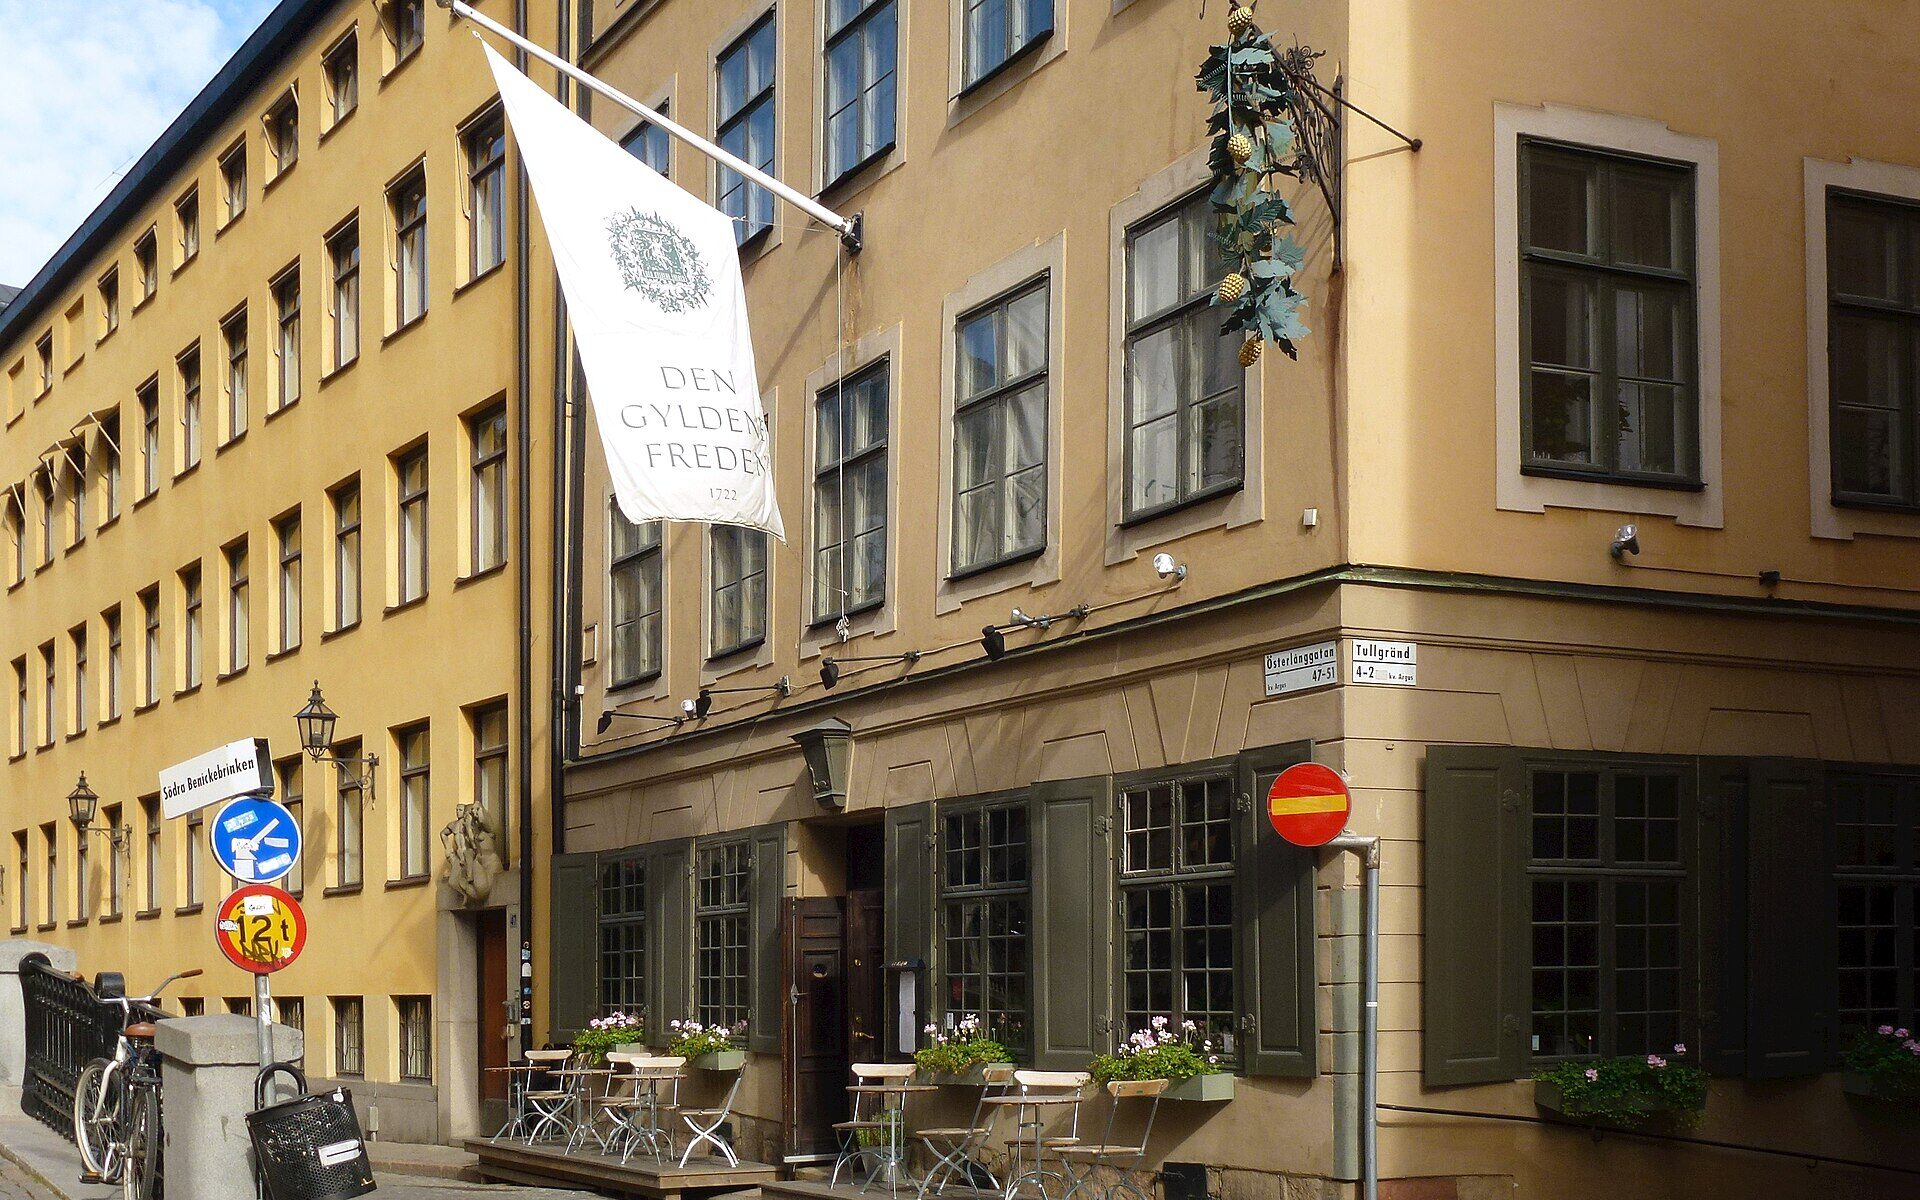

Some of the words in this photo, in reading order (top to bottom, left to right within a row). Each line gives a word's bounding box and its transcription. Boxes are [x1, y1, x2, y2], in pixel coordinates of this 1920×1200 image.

[660, 366, 737, 395] DEN
[710, 487, 737, 501] 1722
[1266, 647, 1335, 670] Österlånggatan
[1356, 644, 1410, 660] Tullgränd
[1312, 666, 1335, 682] 47-51
[1356, 665, 1374, 678] 4-2
[1398, 673, 1414, 682] Argus
[163, 781, 186, 800] Södra
[187, 758, 254, 791] Benickebrinken
[236, 915, 272, 943] 12
[280, 918, 289, 941] t
